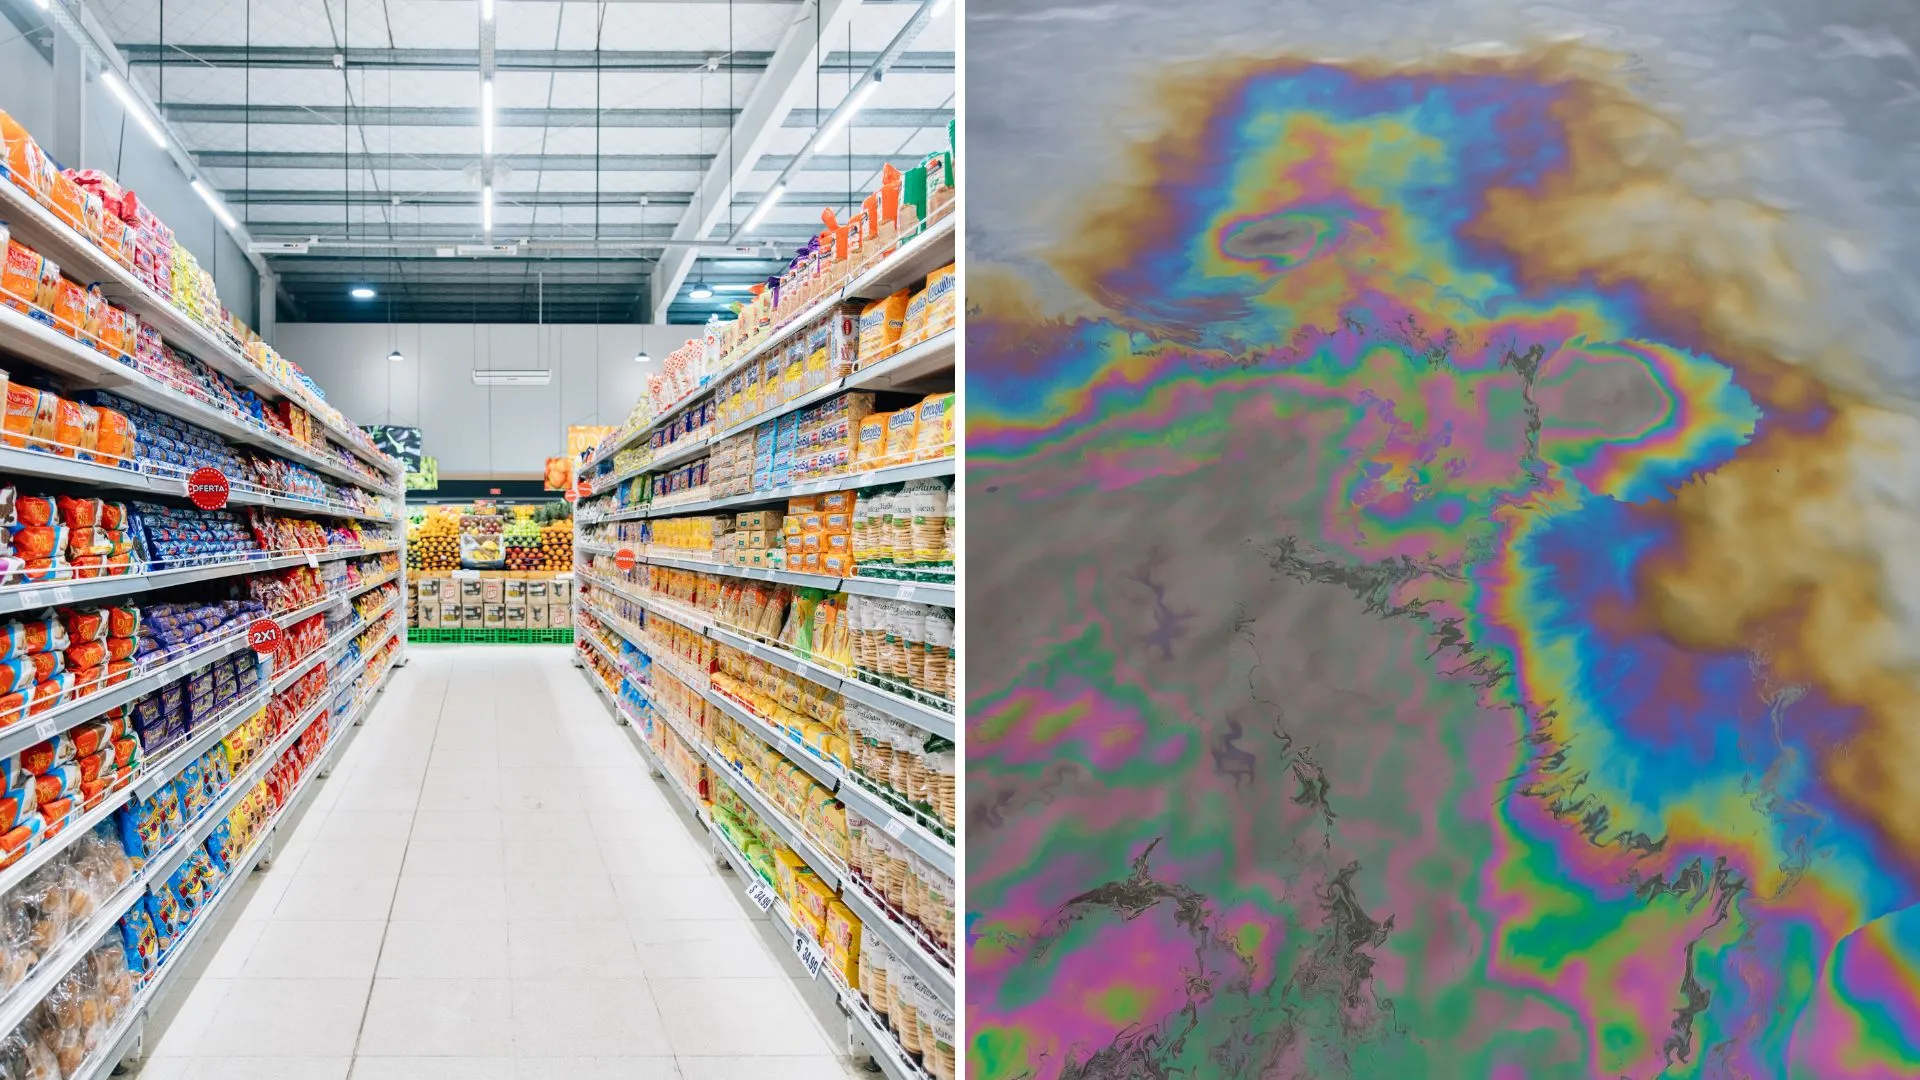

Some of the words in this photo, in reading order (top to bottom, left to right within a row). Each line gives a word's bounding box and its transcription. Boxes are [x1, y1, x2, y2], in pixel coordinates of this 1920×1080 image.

[192, 484, 225, 492] OFERTA
[253, 628, 277, 644] 2X1
[796, 939, 803, 952] $
